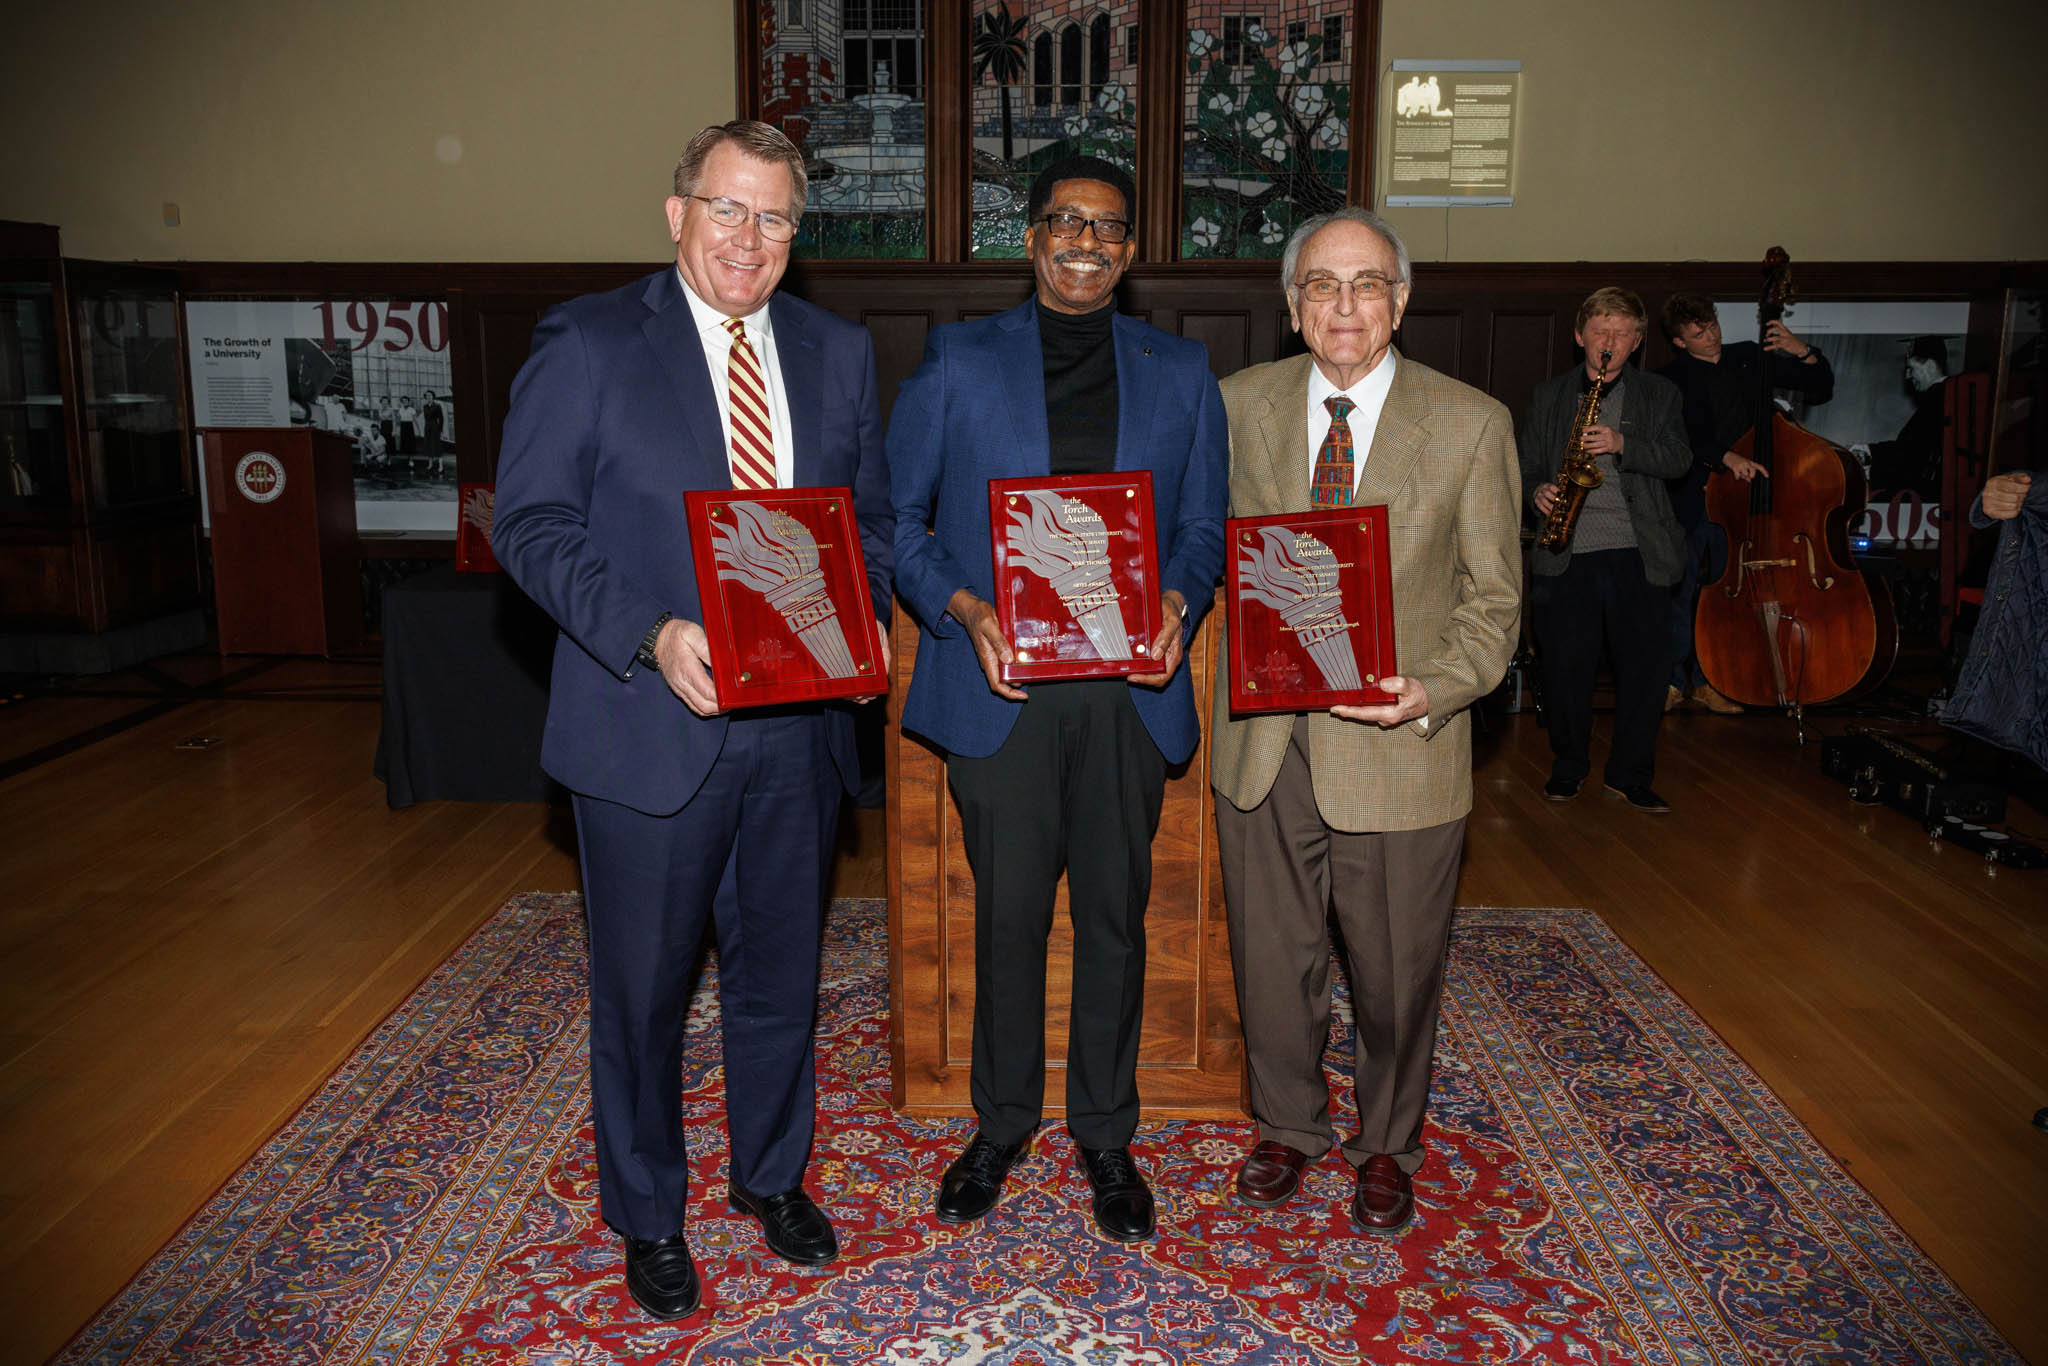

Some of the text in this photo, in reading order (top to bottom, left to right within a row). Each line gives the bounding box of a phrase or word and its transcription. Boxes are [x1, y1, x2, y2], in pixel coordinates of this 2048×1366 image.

[203, 337, 272, 347] The Growth of
[212, 349, 262, 360] University
[1070, 496, 1081, 504] the
[776, 508, 788, 516] the
[1061, 503, 1088, 515] Torch
[1065, 513, 1102, 525] Awards
[1301, 531, 1313, 539] the
[1293, 537, 1320, 549] Torch
[1296, 546, 1334, 558] Awards
